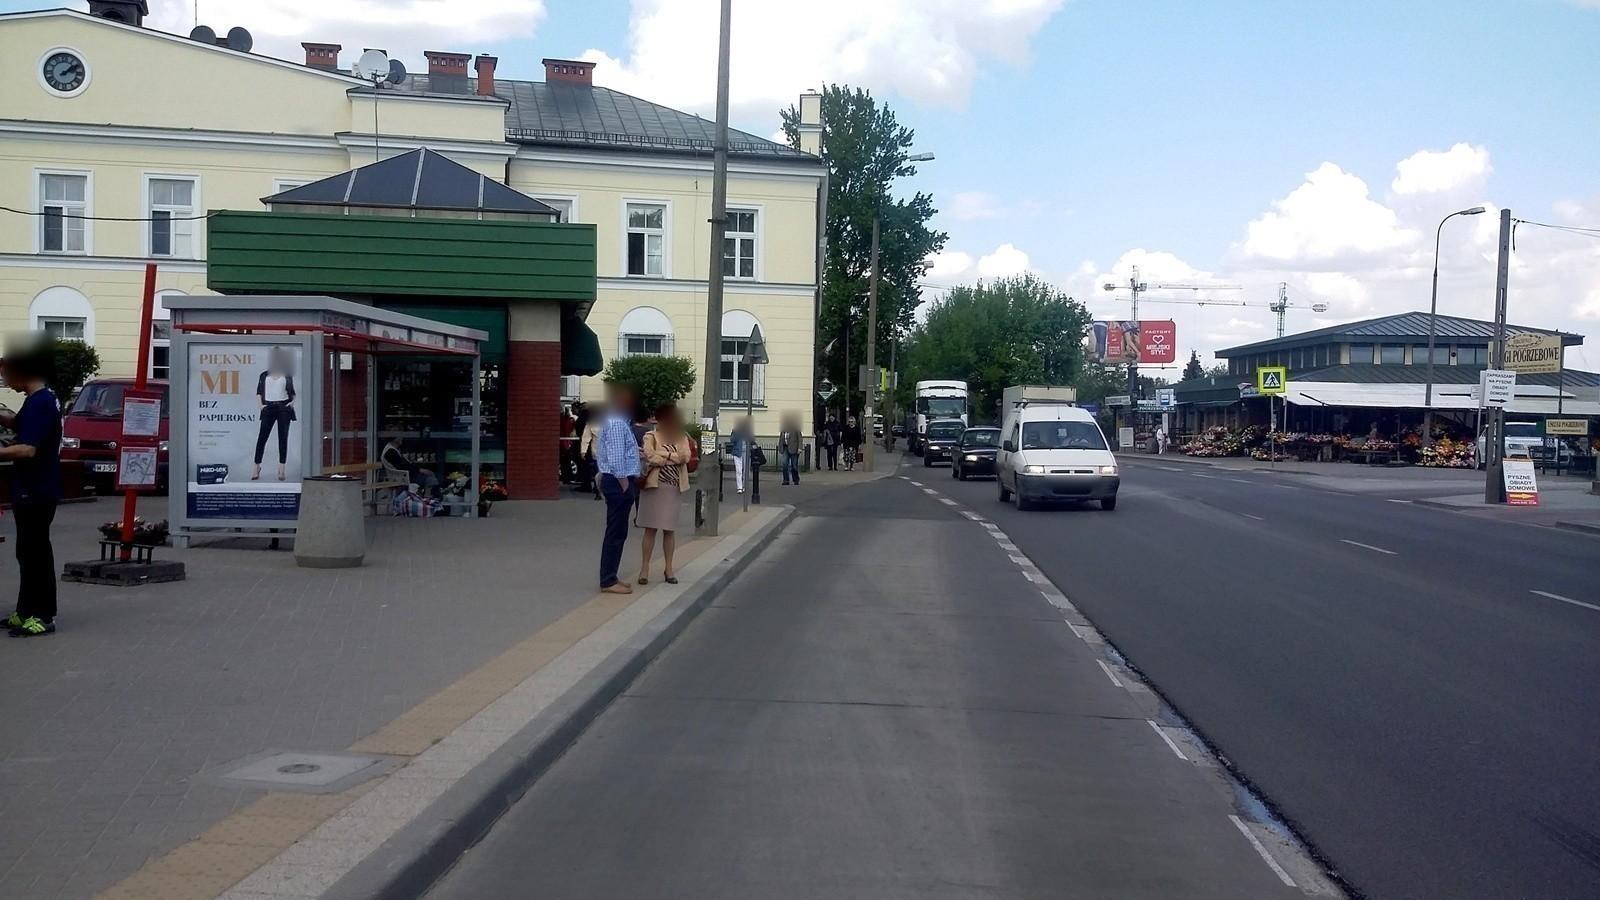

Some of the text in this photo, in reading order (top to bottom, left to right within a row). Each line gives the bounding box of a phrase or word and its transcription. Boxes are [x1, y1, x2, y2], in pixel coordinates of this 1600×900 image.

[1513, 347, 1559, 362] POGRZEBOWE
[200, 370, 240, 395] MI
[199, 400, 218, 409] BEZ
